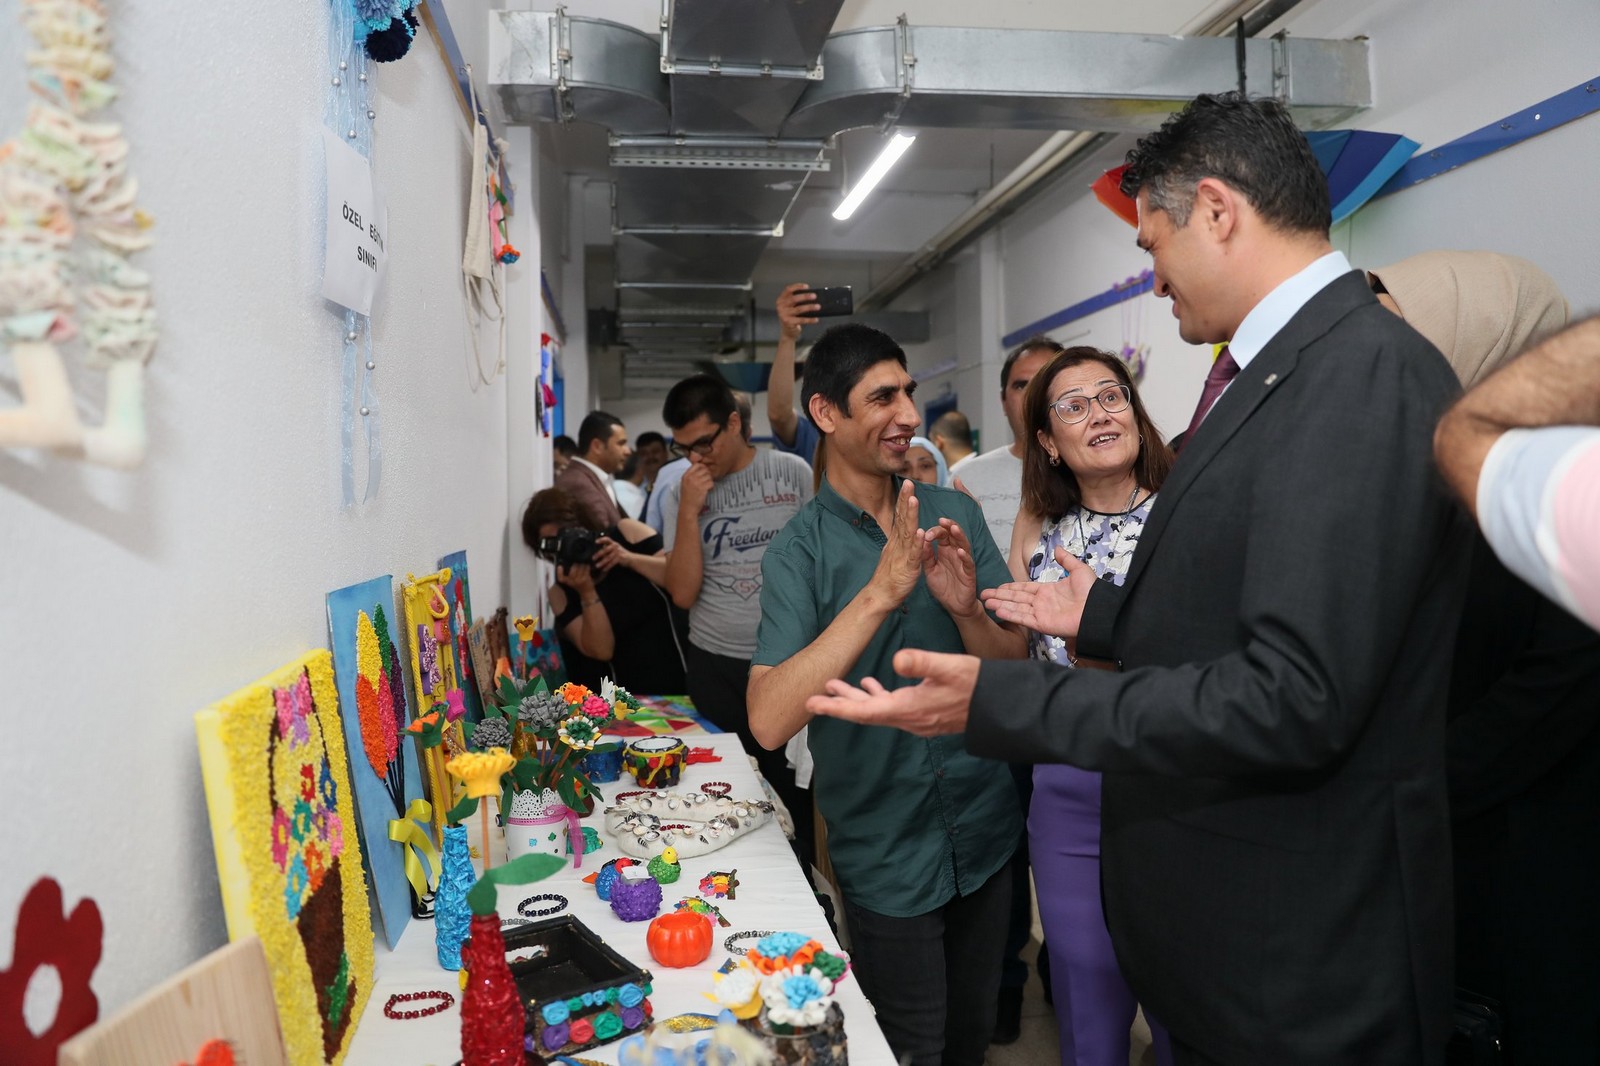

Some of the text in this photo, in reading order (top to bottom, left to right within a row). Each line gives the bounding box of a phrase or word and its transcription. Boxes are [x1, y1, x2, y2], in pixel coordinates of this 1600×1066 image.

[342, 200, 364, 231] ÖZEL
[357, 245, 377, 272] SINIFI
[763, 493, 796, 505] CLASS
